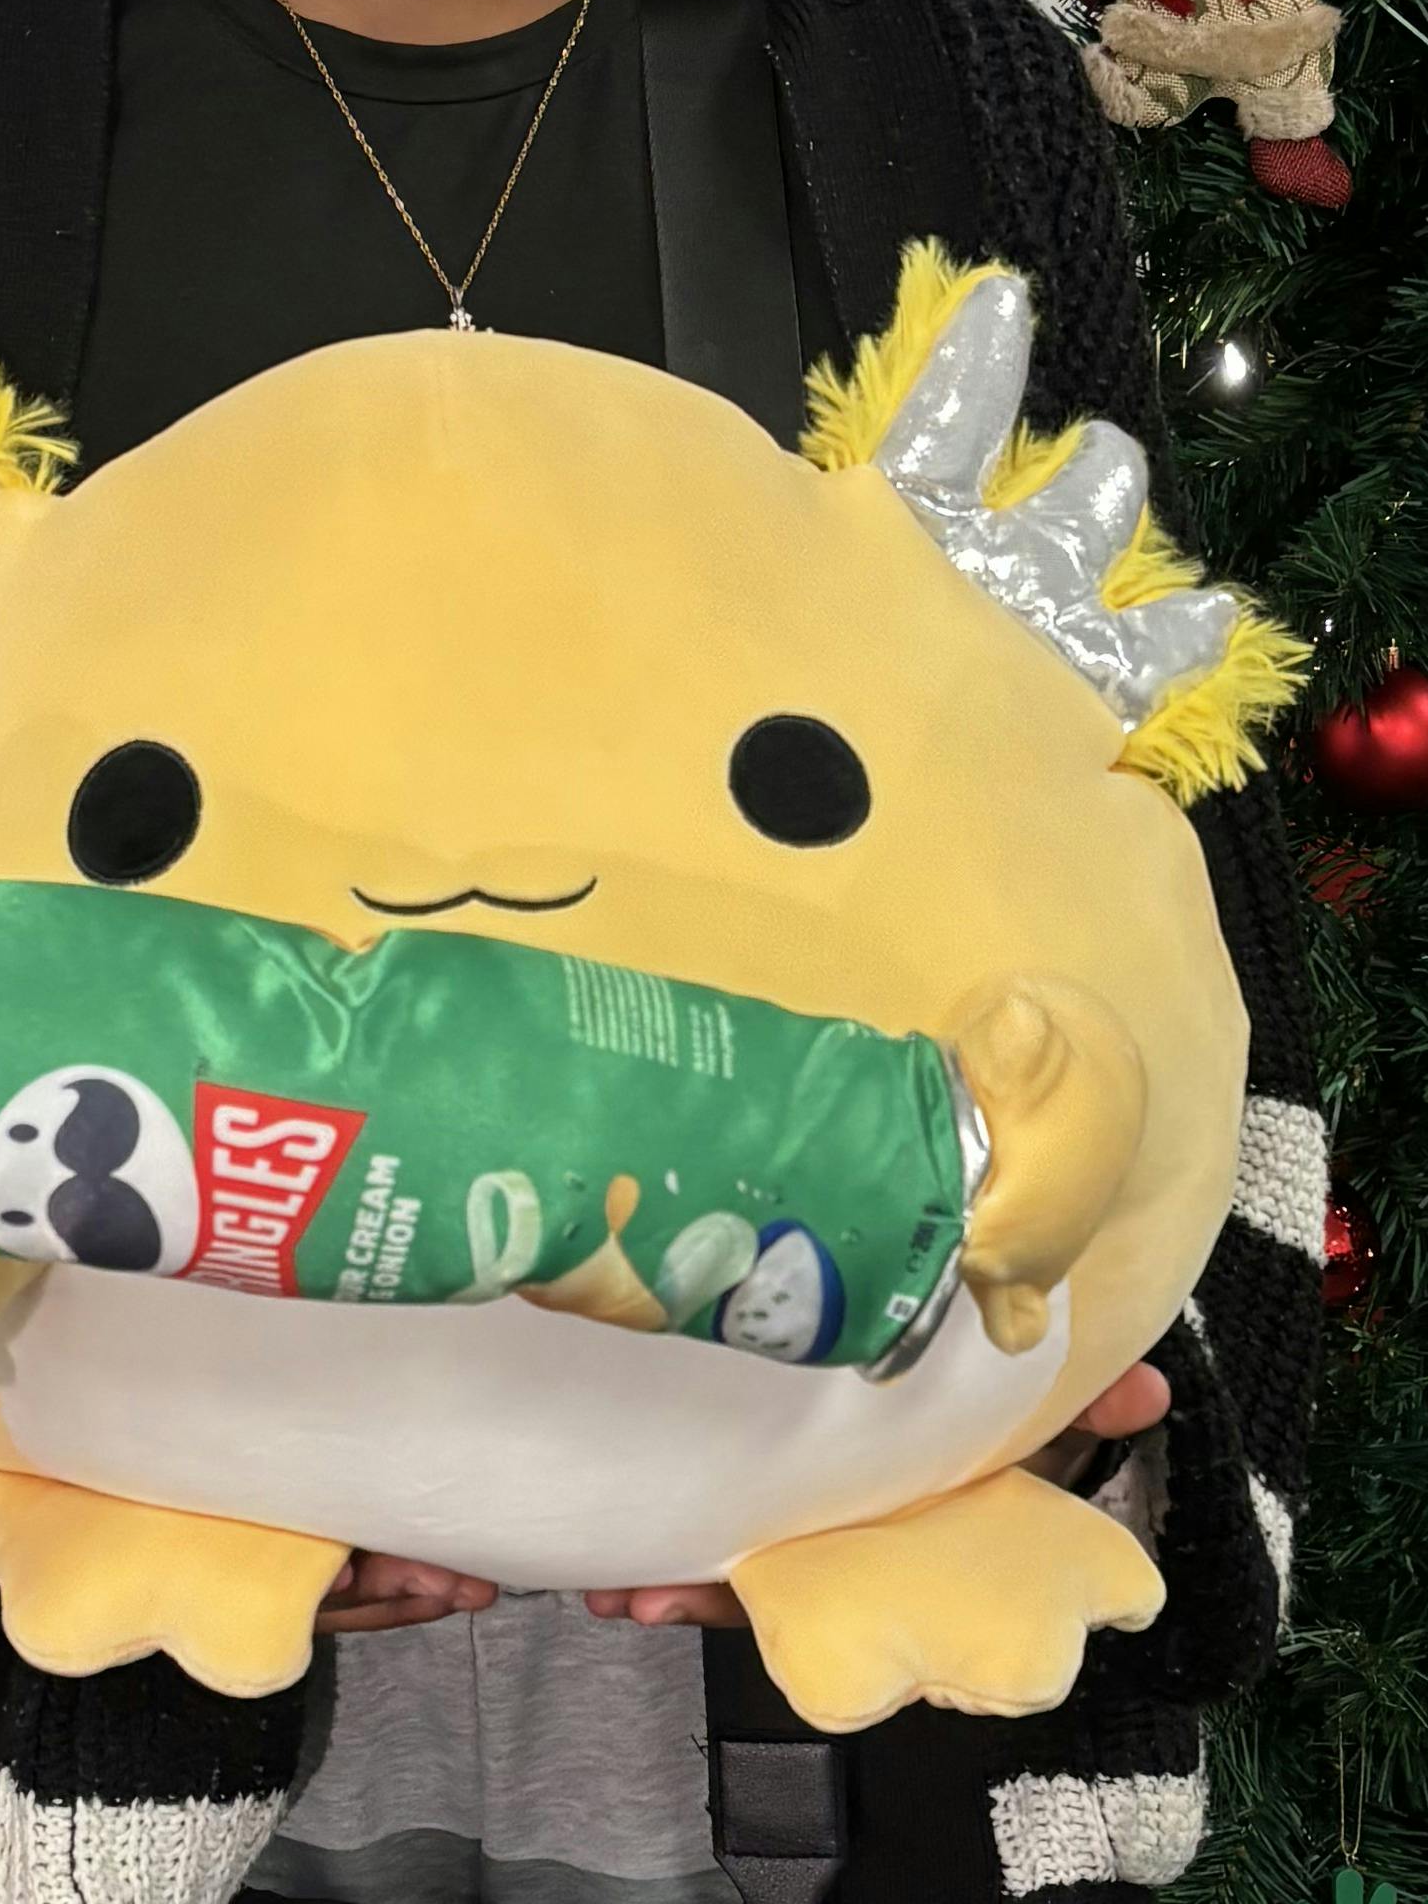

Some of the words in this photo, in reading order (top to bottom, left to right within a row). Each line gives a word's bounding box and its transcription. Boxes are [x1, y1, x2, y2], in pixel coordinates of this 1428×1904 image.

[187, 1103, 339, 1295] RINGLES
[345, 1153, 402, 1266] CREAM
[371, 1196, 423, 1288] ONION
